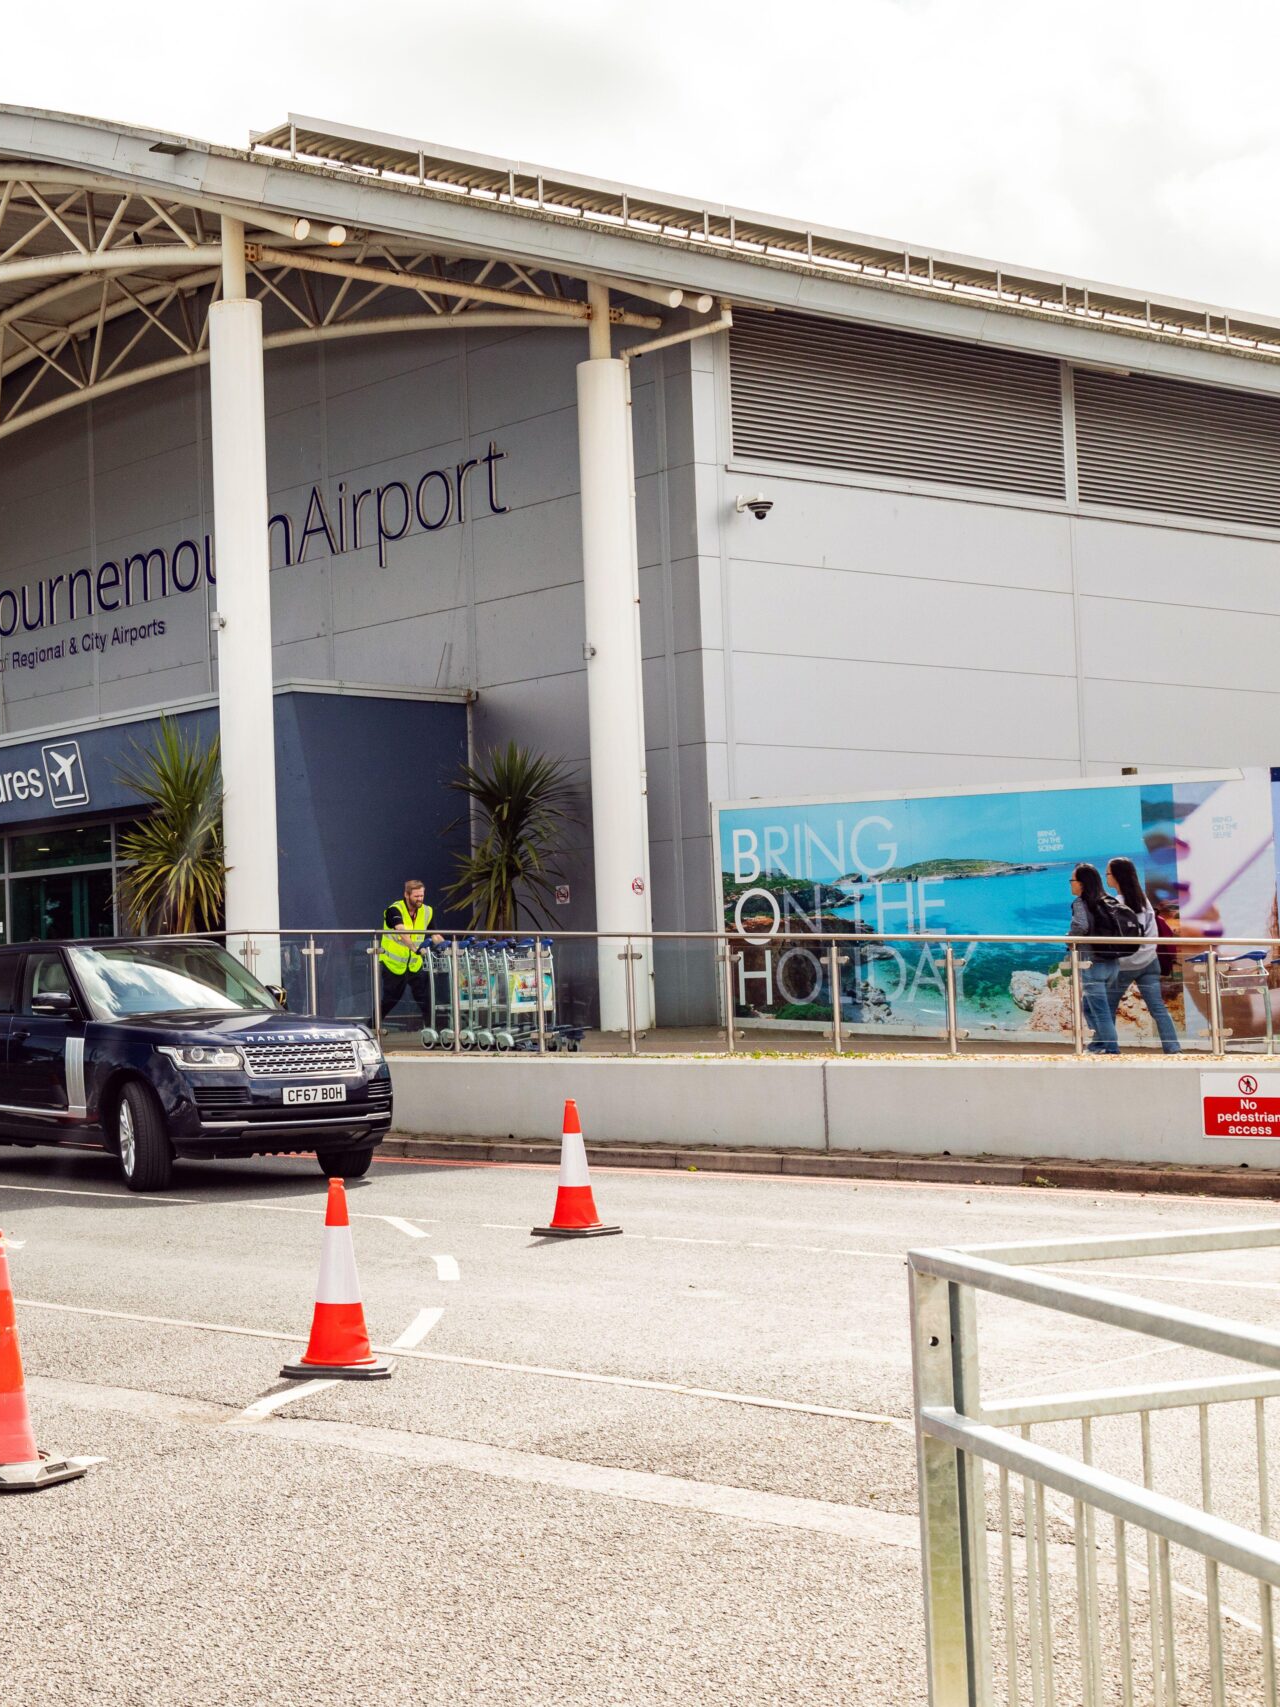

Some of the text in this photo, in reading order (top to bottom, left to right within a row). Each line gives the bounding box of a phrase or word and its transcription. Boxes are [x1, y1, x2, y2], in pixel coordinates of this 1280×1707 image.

[12, 640, 65, 669] Regional
[69, 637, 78, 655] &
[82, 632, 108, 654] City
[111, 617, 167, 645] Airports
[732, 815, 898, 884] BRING
[735, 878, 947, 945] ON THE
[246, 1034, 295, 1042] RANGE
[287, 1086, 343, 1102] CF67 BOH
[1240, 1098, 1258, 1110] No
[1217, 1111, 1280, 1124] pedestrian
[1228, 1125, 1272, 1135] access
